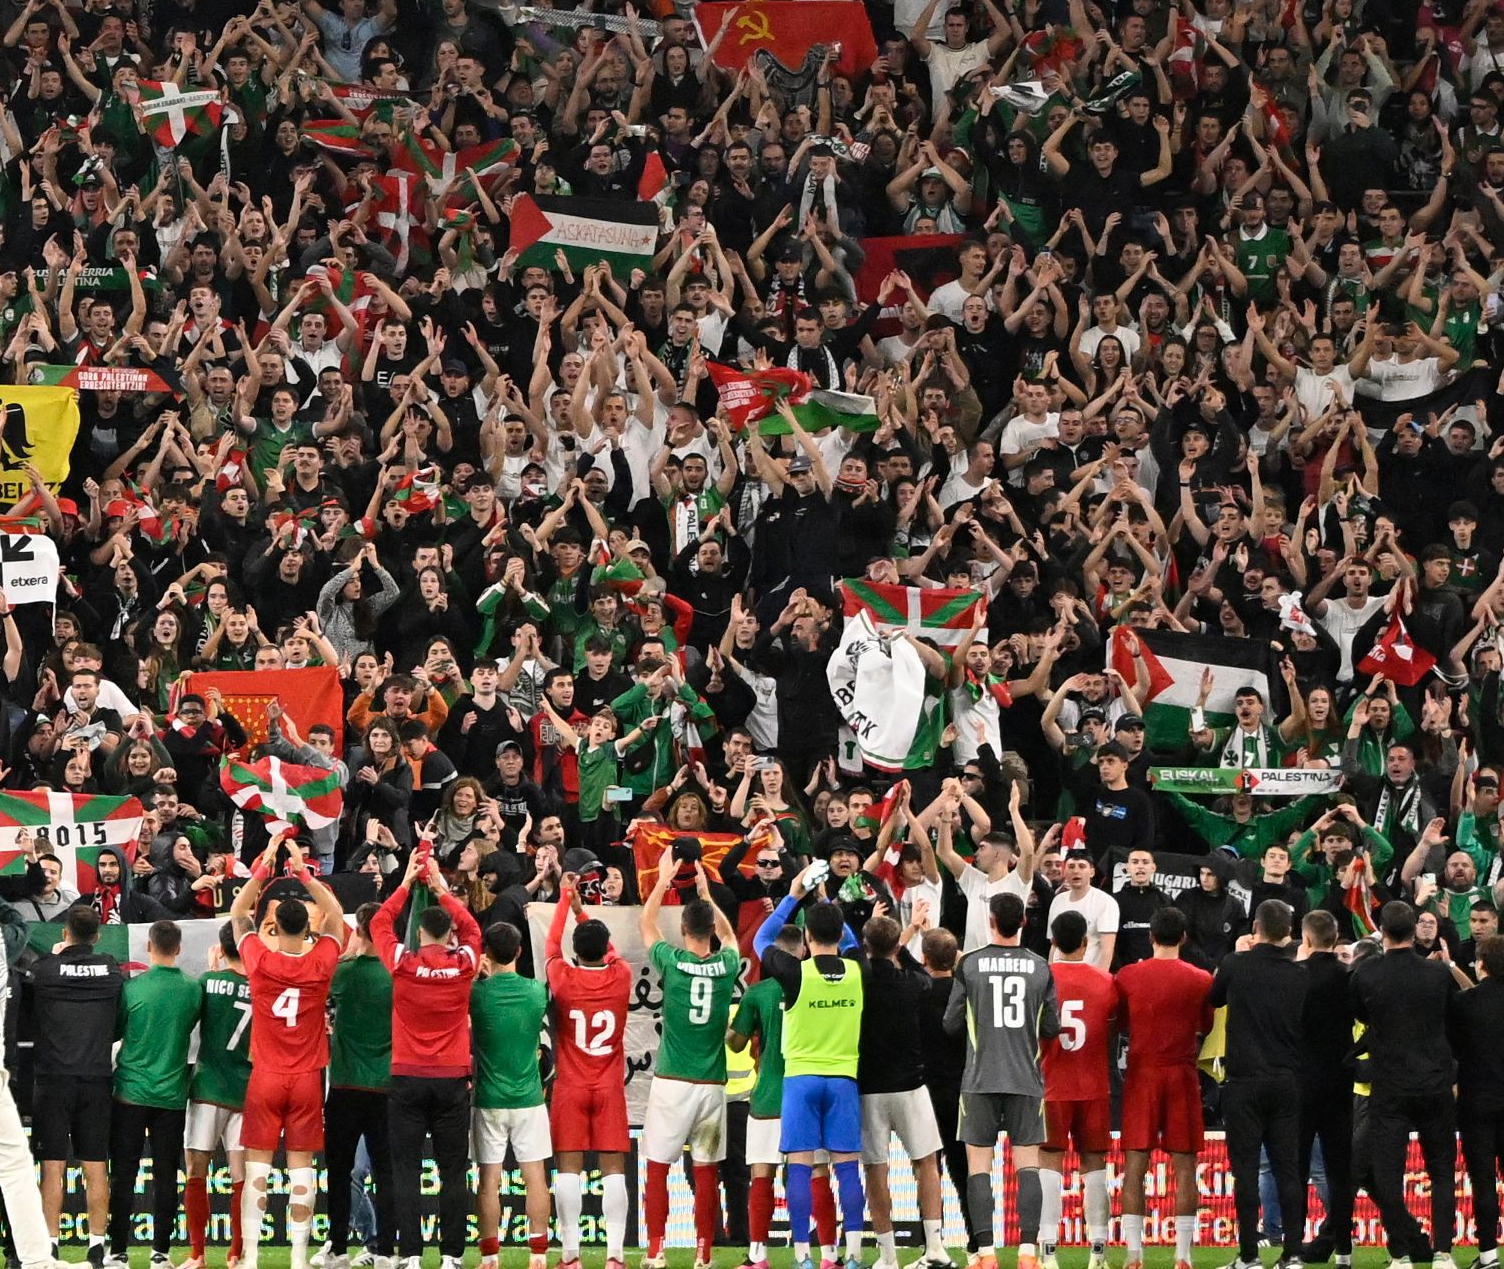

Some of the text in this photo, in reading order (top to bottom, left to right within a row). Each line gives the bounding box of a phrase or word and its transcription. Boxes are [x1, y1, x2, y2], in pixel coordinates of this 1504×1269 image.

[557, 221, 642, 247] ASKATASUNA
[1248, 255, 1258, 270] 7
[10, 575, 49, 588] etxera
[1160, 769, 1220, 781] EUSKAL
[59, 963, 110, 977] PALESTINE
[978, 957, 1036, 974] MARRERO
[205, 978, 234, 995] NICO
[271, 987, 300, 1028] 4
[688, 976, 713, 1025] 9
[808, 999, 848, 1009] KELME
[989, 975, 1026, 1029] 13
[225, 1000, 252, 1051] 7
[569, 1009, 616, 1056] 12
[1059, 999, 1087, 1052] 5
